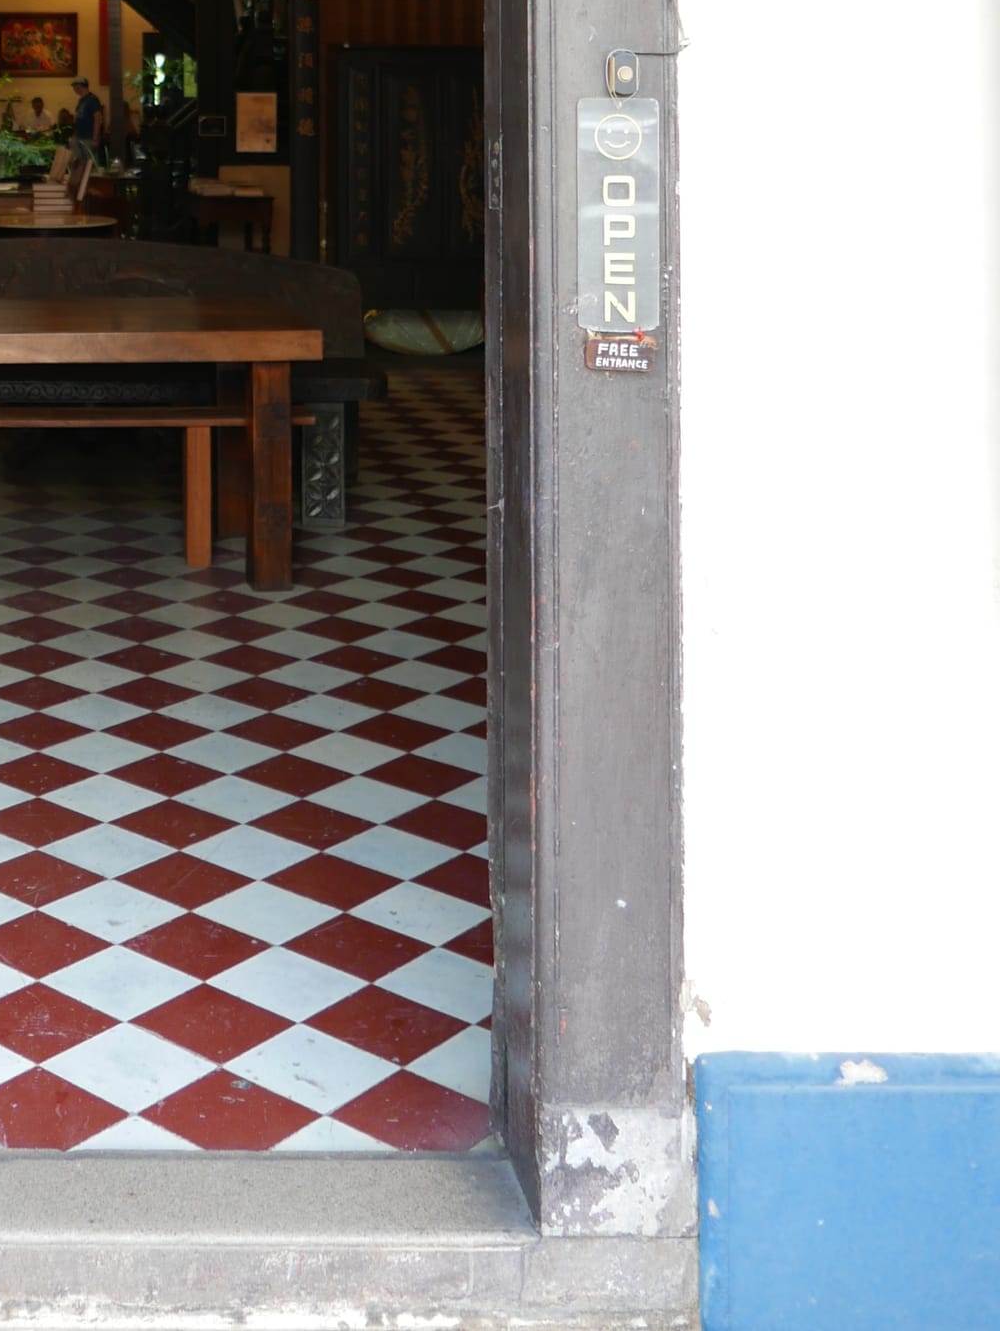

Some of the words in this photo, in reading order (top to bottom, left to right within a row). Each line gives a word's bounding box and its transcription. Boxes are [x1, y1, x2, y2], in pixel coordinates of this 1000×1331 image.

[603, 175, 636, 323] OPEN
[597, 343, 639, 357] FREE
[595, 357, 649, 369] ENTRANCE
